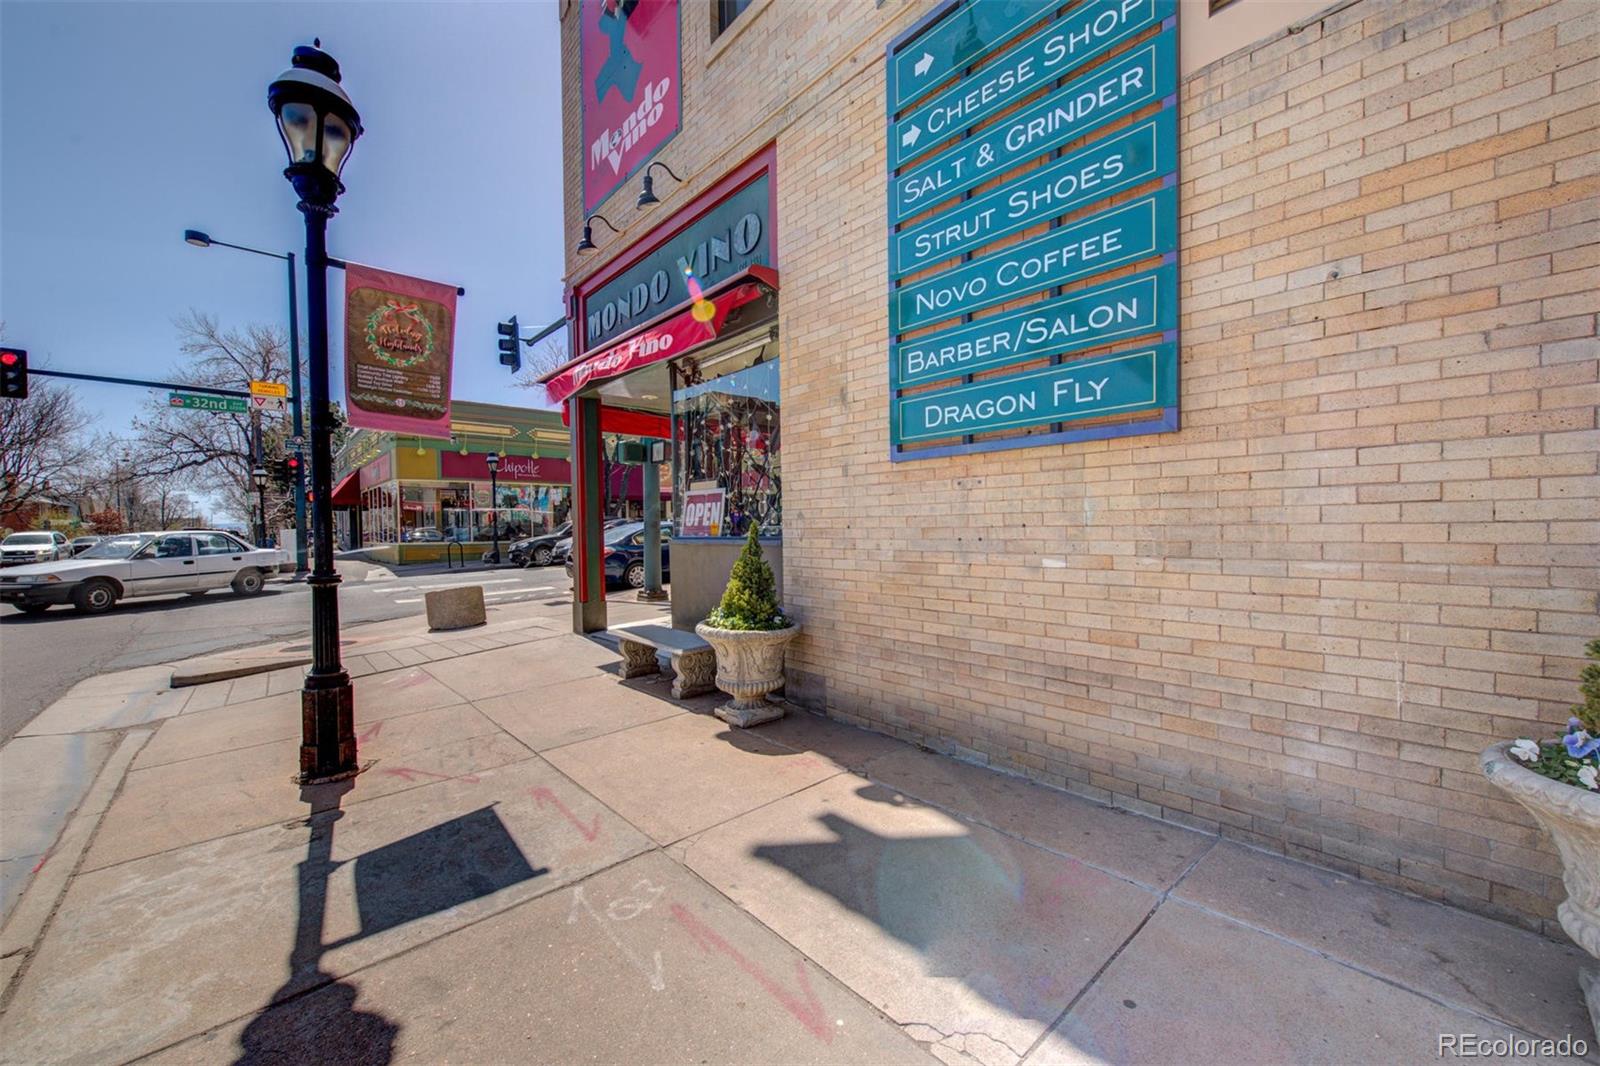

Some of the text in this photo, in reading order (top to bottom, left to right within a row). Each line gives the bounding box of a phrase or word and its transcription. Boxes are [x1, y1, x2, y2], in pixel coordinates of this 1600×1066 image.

[926, 0, 1144, 134] CHEESE SHOP
[607, 102, 664, 176] Vino
[904, 66, 1144, 204] SALT & GRINDER
[915, 154, 1124, 258] STRUT SHOES
[588, 213, 762, 342] MONDO VINO
[916, 228, 1122, 315] NOVO COFFEE
[907, 298, 1137, 374] BARBER/SALON
[192, 397, 227, 410] 32nd
[925, 377, 1110, 428] DRAGON FLY
[685, 501, 721, 527] OPEN
